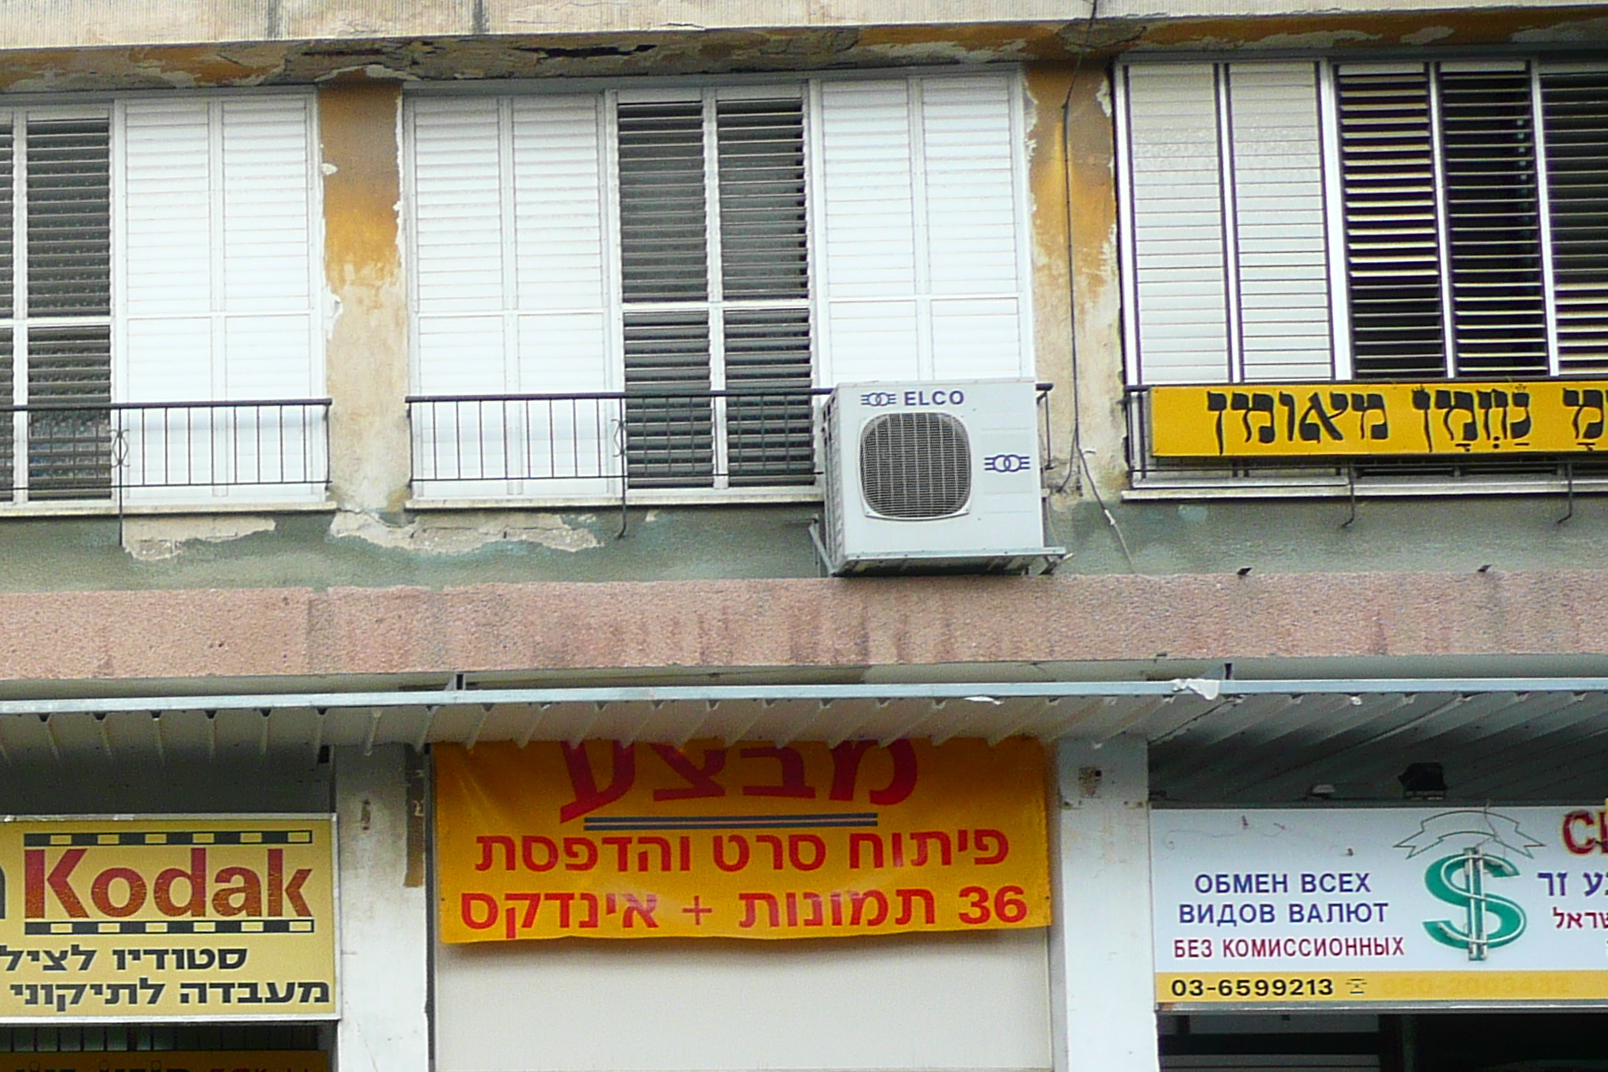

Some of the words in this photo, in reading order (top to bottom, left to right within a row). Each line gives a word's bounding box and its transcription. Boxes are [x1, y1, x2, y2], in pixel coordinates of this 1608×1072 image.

[904, 390, 965, 406] ELCO
[561, 739, 919, 824] מבצע
[475, 834, 691, 873] והדפסת
[712, 833, 827, 872] סרט
[848, 828, 1010, 871] פיתוח
[24, 847, 314, 919] Kodak
[1195, 873, 1289, 895] ОБМЕН
[1300, 872, 1372, 894] ВСЕХ
[459, 890, 659, 940] אינדקס
[739, 888, 937, 928] תמונות
[958, 885, 1028, 925] 36
[1178, 903, 1277, 928] ВИДОВ
[1289, 902, 1390, 924] ВАЛЮТ
[112, 947, 248, 971] סטודיו
[1173, 939, 1214, 958] БЕЗ
[1223, 936, 1406, 958] КОМИССИОННЫХ
[9, 976, 166, 1013] לתיקוני
[180, 980, 331, 1005] מעבדה
[1171, 978, 1335, 997] 03-6599213
